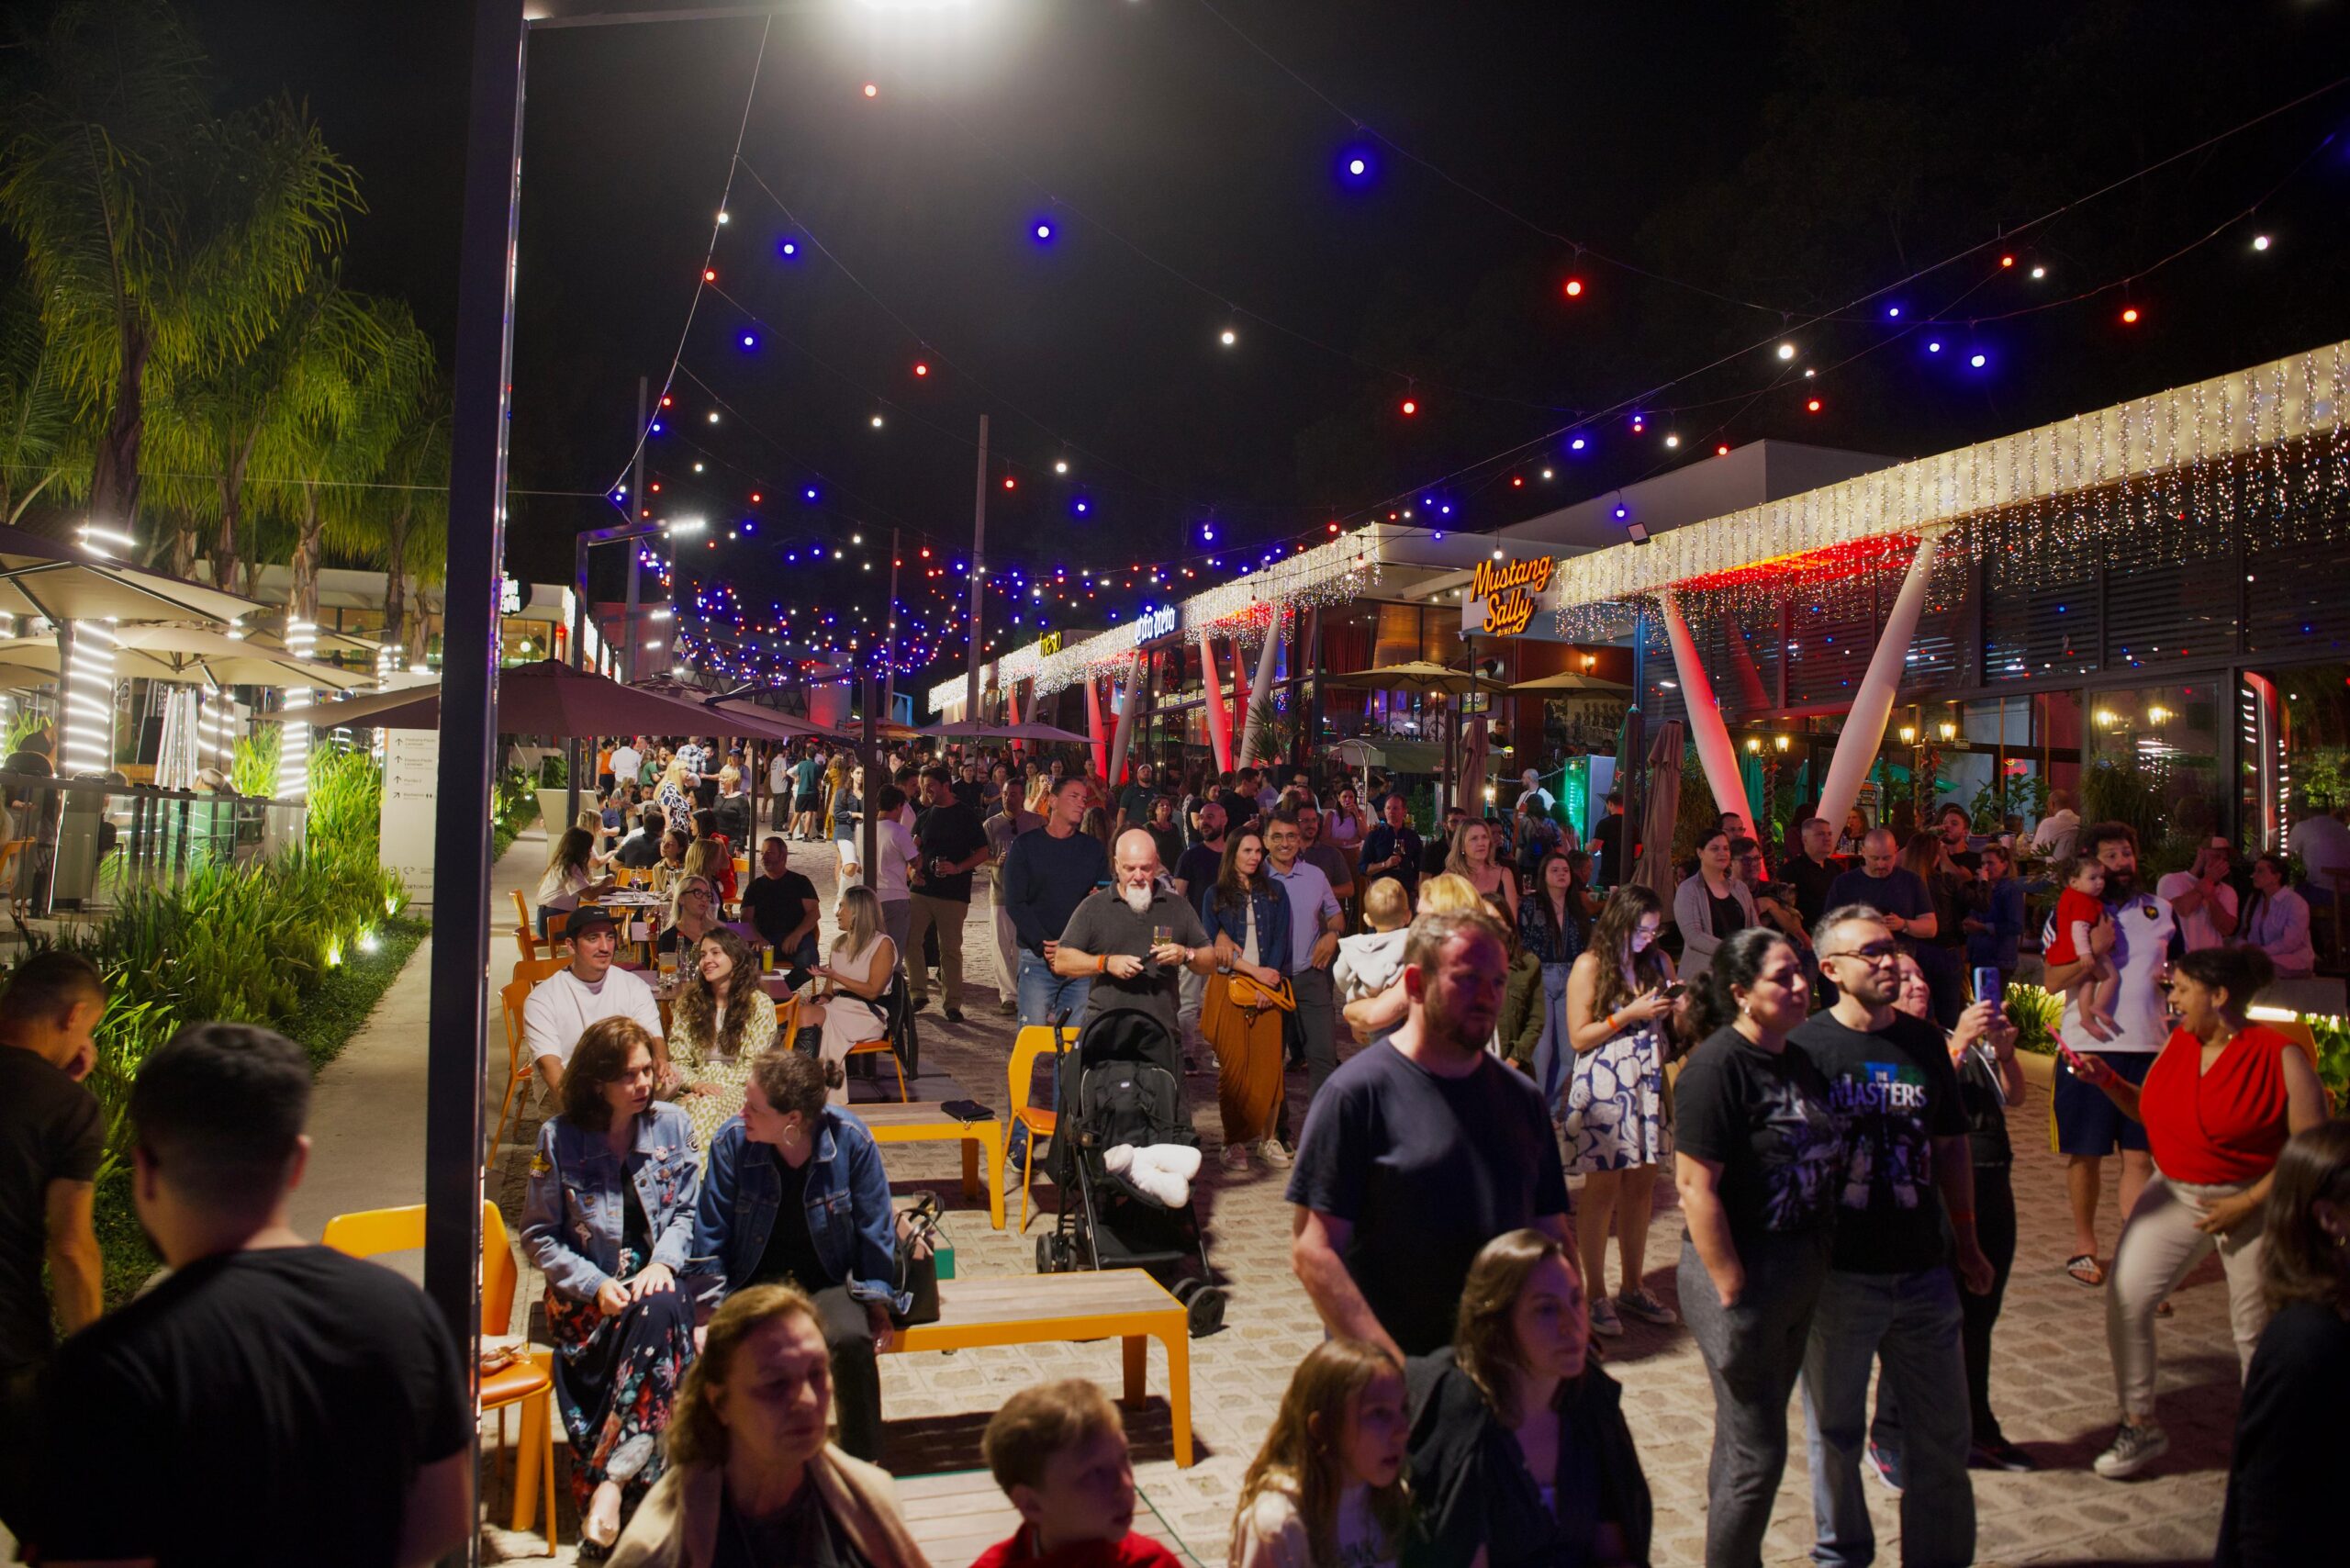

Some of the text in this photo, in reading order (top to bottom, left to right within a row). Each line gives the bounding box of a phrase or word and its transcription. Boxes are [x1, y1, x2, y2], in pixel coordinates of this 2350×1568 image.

[1469, 555, 1553, 602] Mustang
[1483, 588, 1534, 633] Sally
[1874, 1070, 1888, 1081] THE
